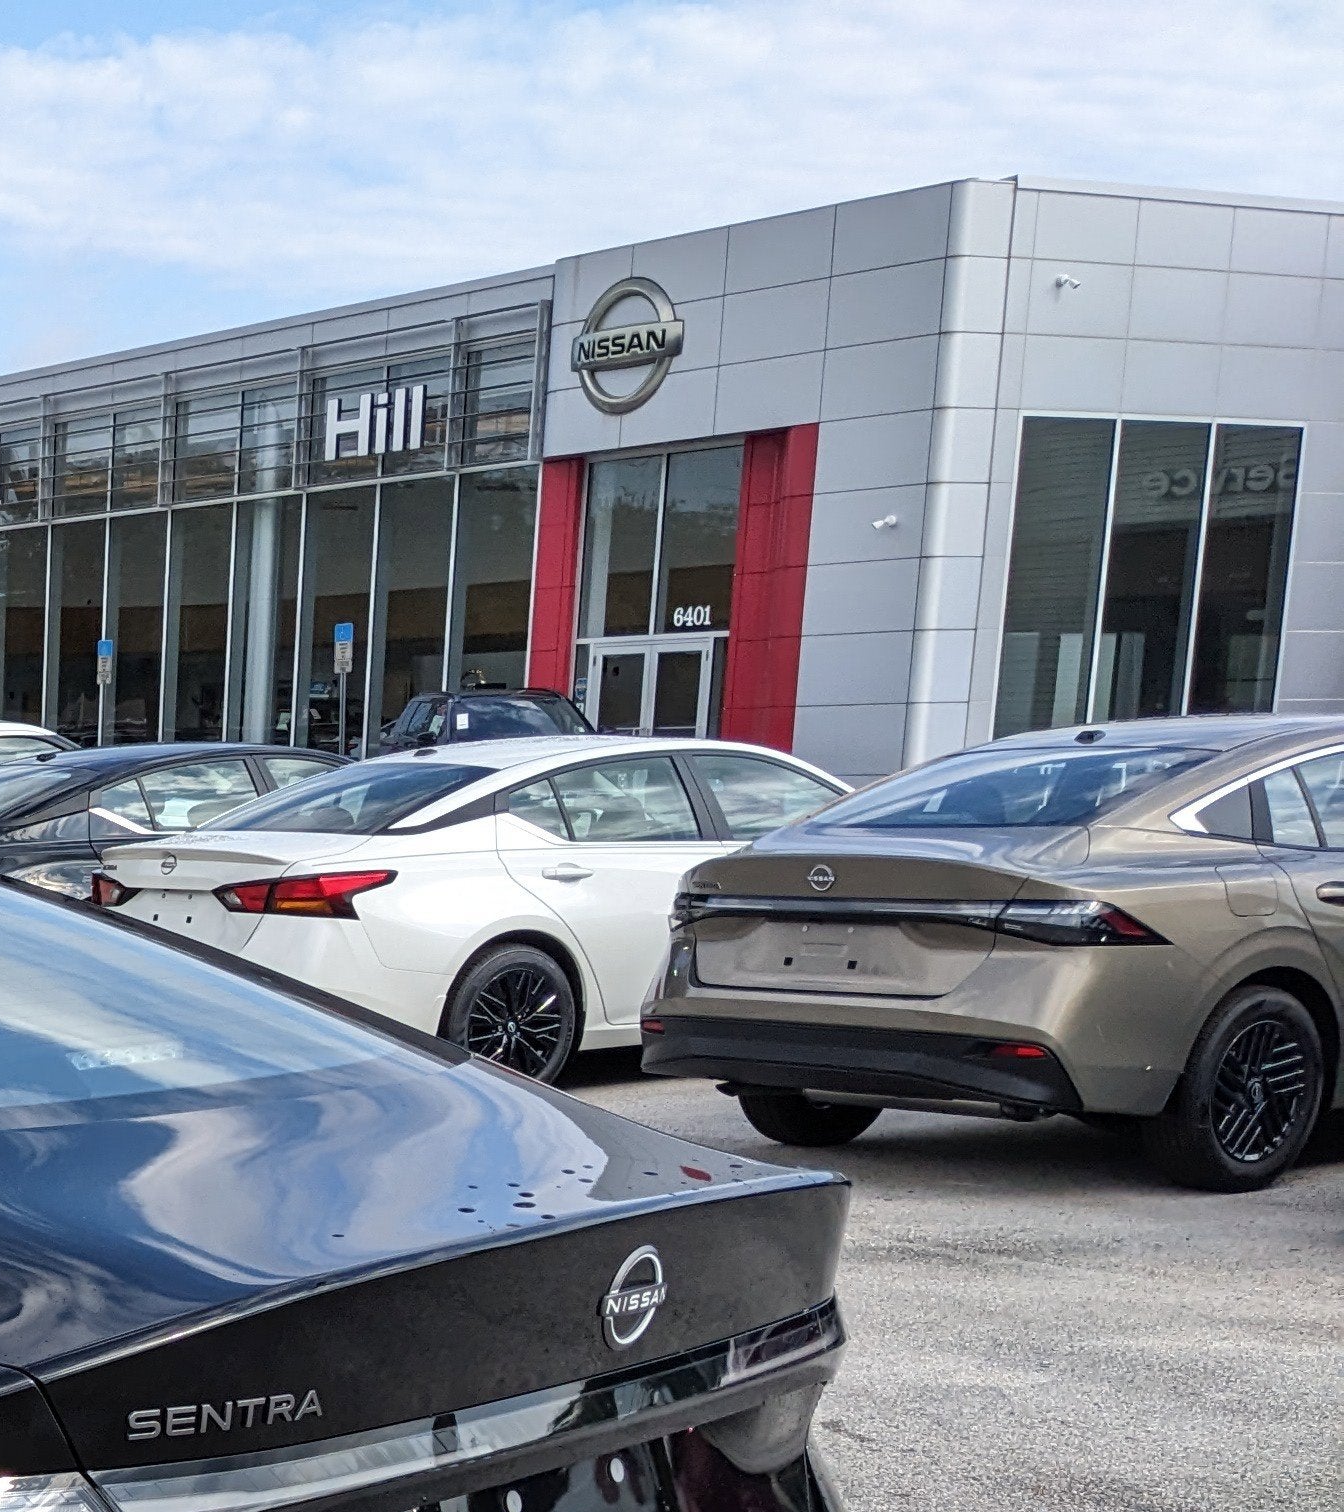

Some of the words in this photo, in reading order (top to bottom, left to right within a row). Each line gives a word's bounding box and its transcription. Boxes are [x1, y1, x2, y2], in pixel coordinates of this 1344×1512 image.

[578, 328, 667, 361] NISSAN
[325, 385, 426, 461] Hill
[673, 605, 711, 627] 6401
[606, 1286, 666, 1314] NISSAN
[127, 1390, 323, 1440] SENTRA
